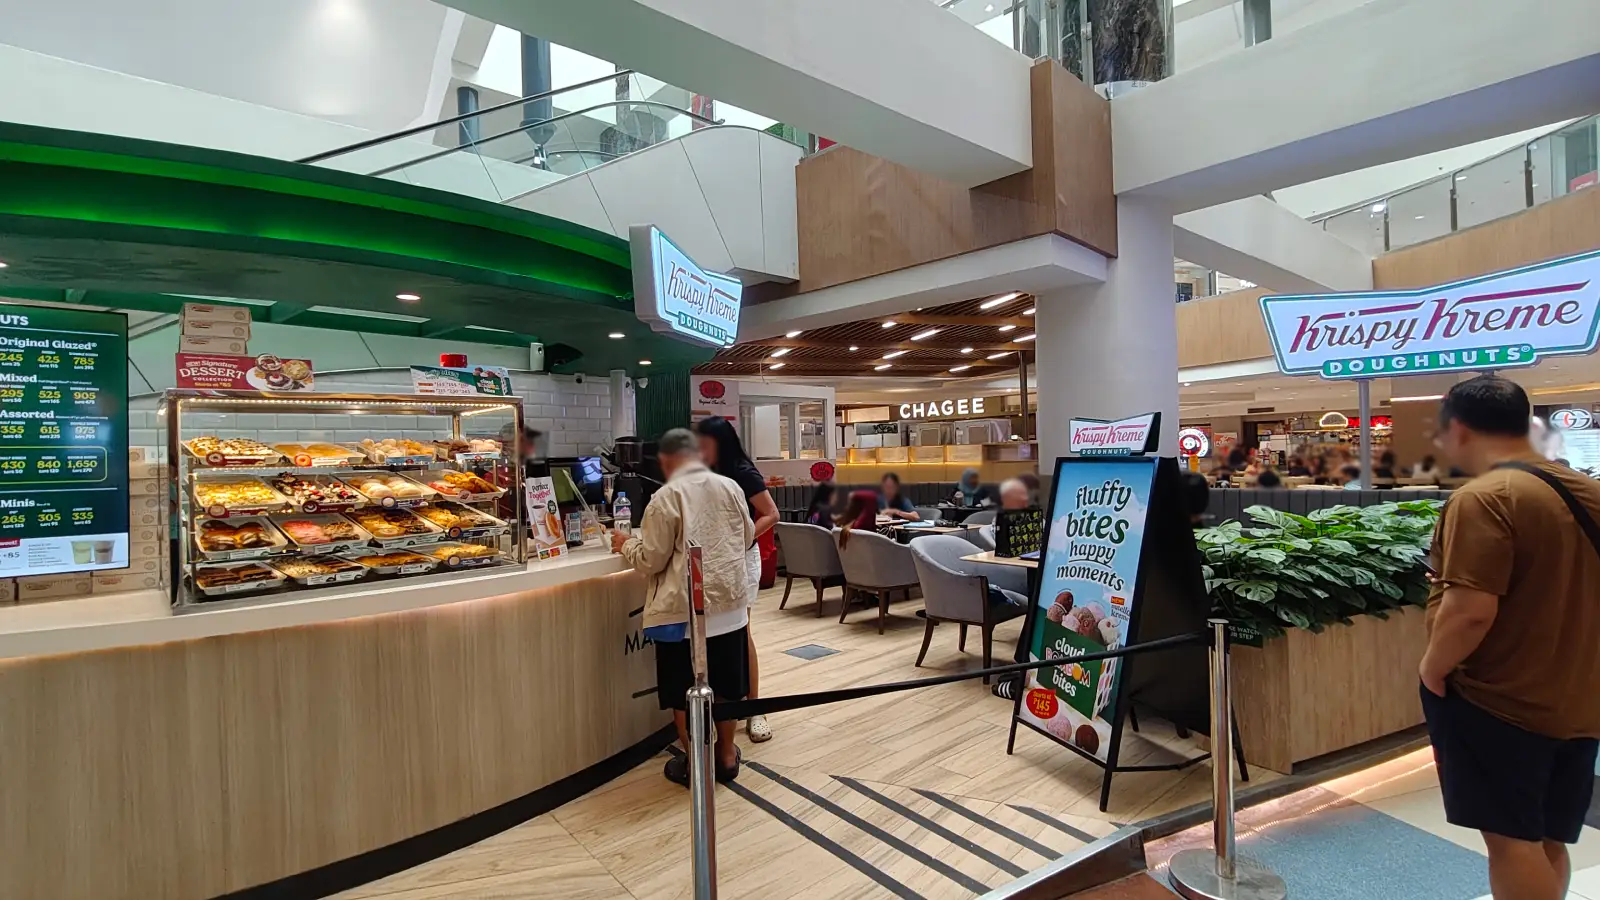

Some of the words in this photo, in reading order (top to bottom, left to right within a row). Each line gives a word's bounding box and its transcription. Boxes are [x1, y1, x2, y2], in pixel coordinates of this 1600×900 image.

[668, 261, 707, 315] Krispy
[706, 282, 738, 323] Kreme
[1289, 300, 1425, 353] Krispy
[1422, 279, 1590, 340] Kreme
[680, 314, 727, 340] DOUGHNUTS
[0, 336, 49, 349] Original
[0, 353, 23, 361] 245
[37, 355, 60, 363] 425
[73, 357, 95, 365] 785
[201, 360, 238, 369] Signature
[179, 366, 245, 380] DESSERT
[0, 373, 37, 383] Mixed
[1, 390, 24, 398] 295
[38, 391, 61, 399] 525
[74, 392, 96, 400] 905
[900, 398, 985, 419] CHAGEE
[0, 410, 54, 419] Assorted
[1, 425, 24, 434] 355
[40, 426, 60, 434] 615
[1072, 426, 1109, 446] Krispy
[1106, 424, 1147, 444] Kreme
[1, 461, 26, 469] 430
[37, 460, 61, 469] 840
[67, 460, 98, 469] 1,650
[528, 489, 551, 500] Together
[1075, 479, 1131, 513] fluffy
[0, 499, 35, 508] Minis
[1, 515, 25, 524] 265
[38, 513, 61, 522] 305
[72, 512, 94, 520] 335
[1066, 510, 1129, 544] bites
[1069, 540, 1115, 565] happy
[1056, 565, 1124, 591] moments
[1237, 627, 1260, 635] WATCH
[1055, 637, 1085, 658] cloud
[1052, 670, 1077, 697] bites
